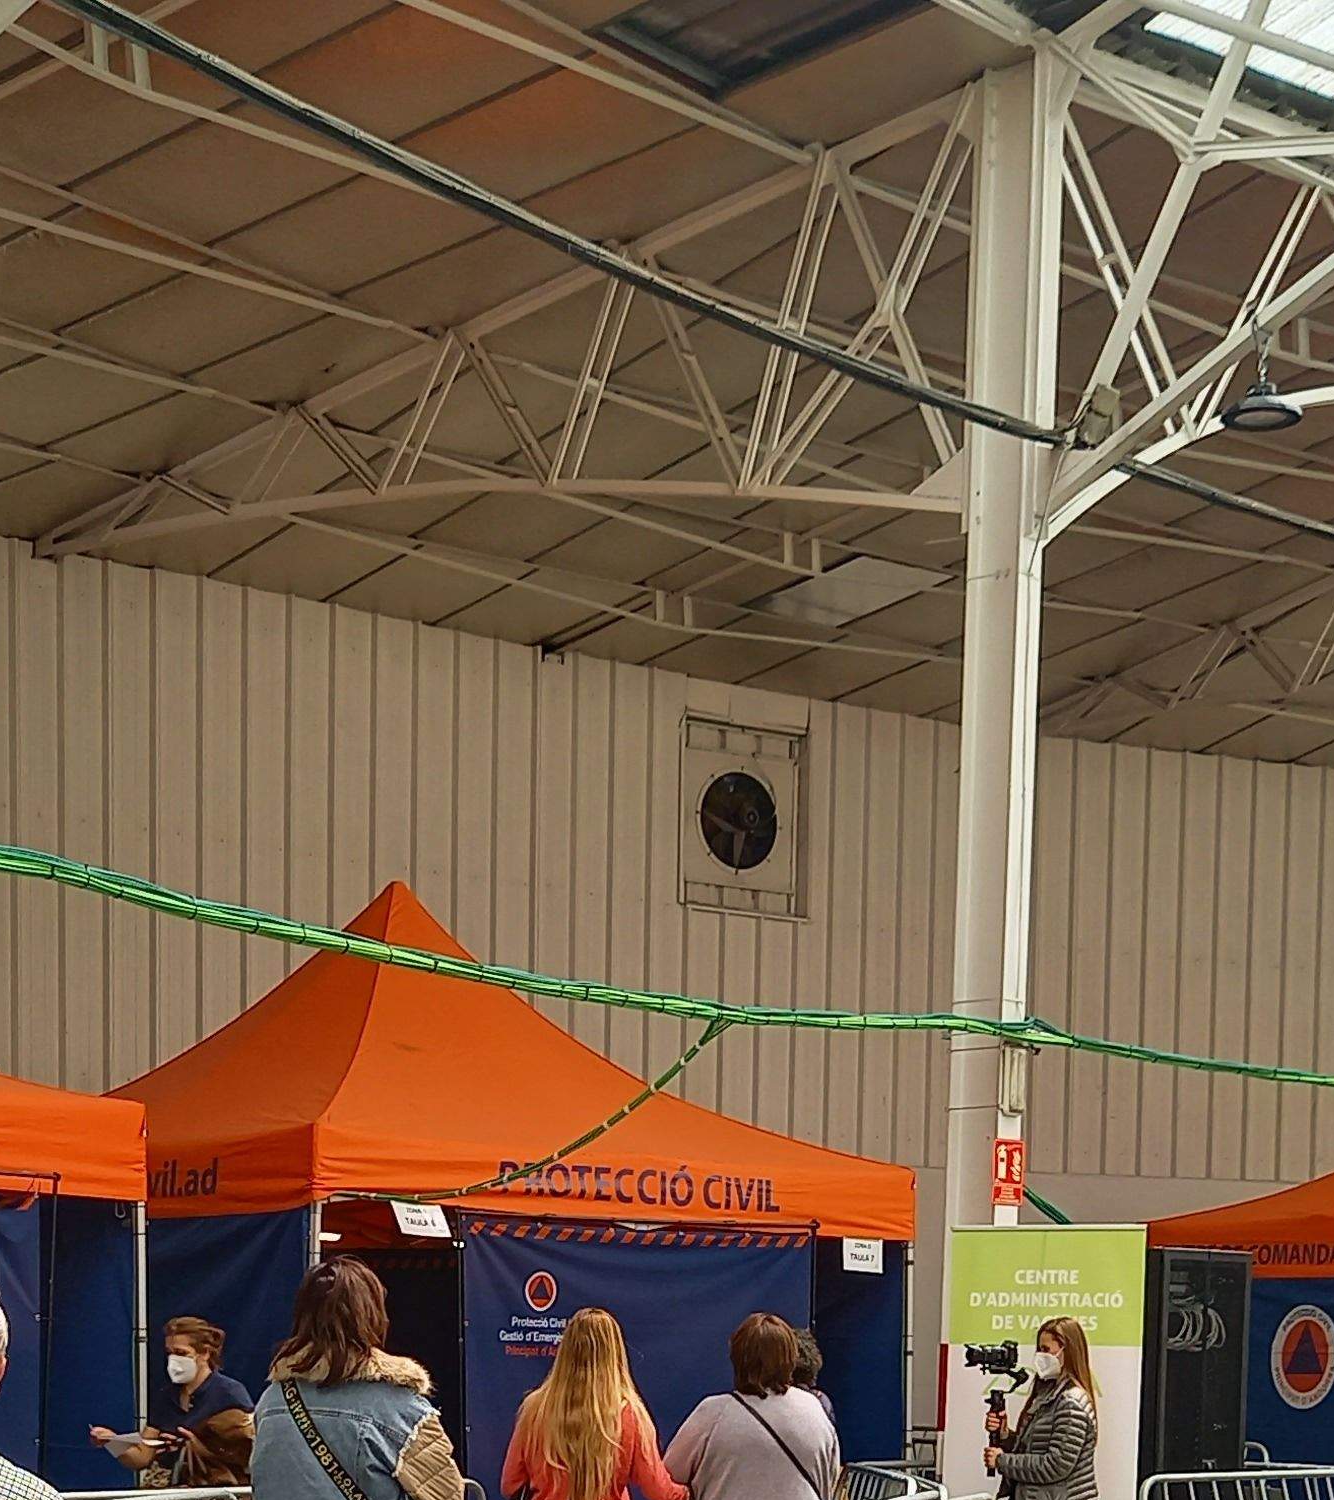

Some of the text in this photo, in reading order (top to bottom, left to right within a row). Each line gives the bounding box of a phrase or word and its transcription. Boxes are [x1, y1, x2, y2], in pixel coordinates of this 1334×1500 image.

[702, 1175, 780, 1213] CIVIL
[1014, 1269, 1080, 1285] CENTRE
[969, 1290, 1124, 1308] D'ADMINISTRACIÓ
[991, 1315, 1015, 1330] DE
